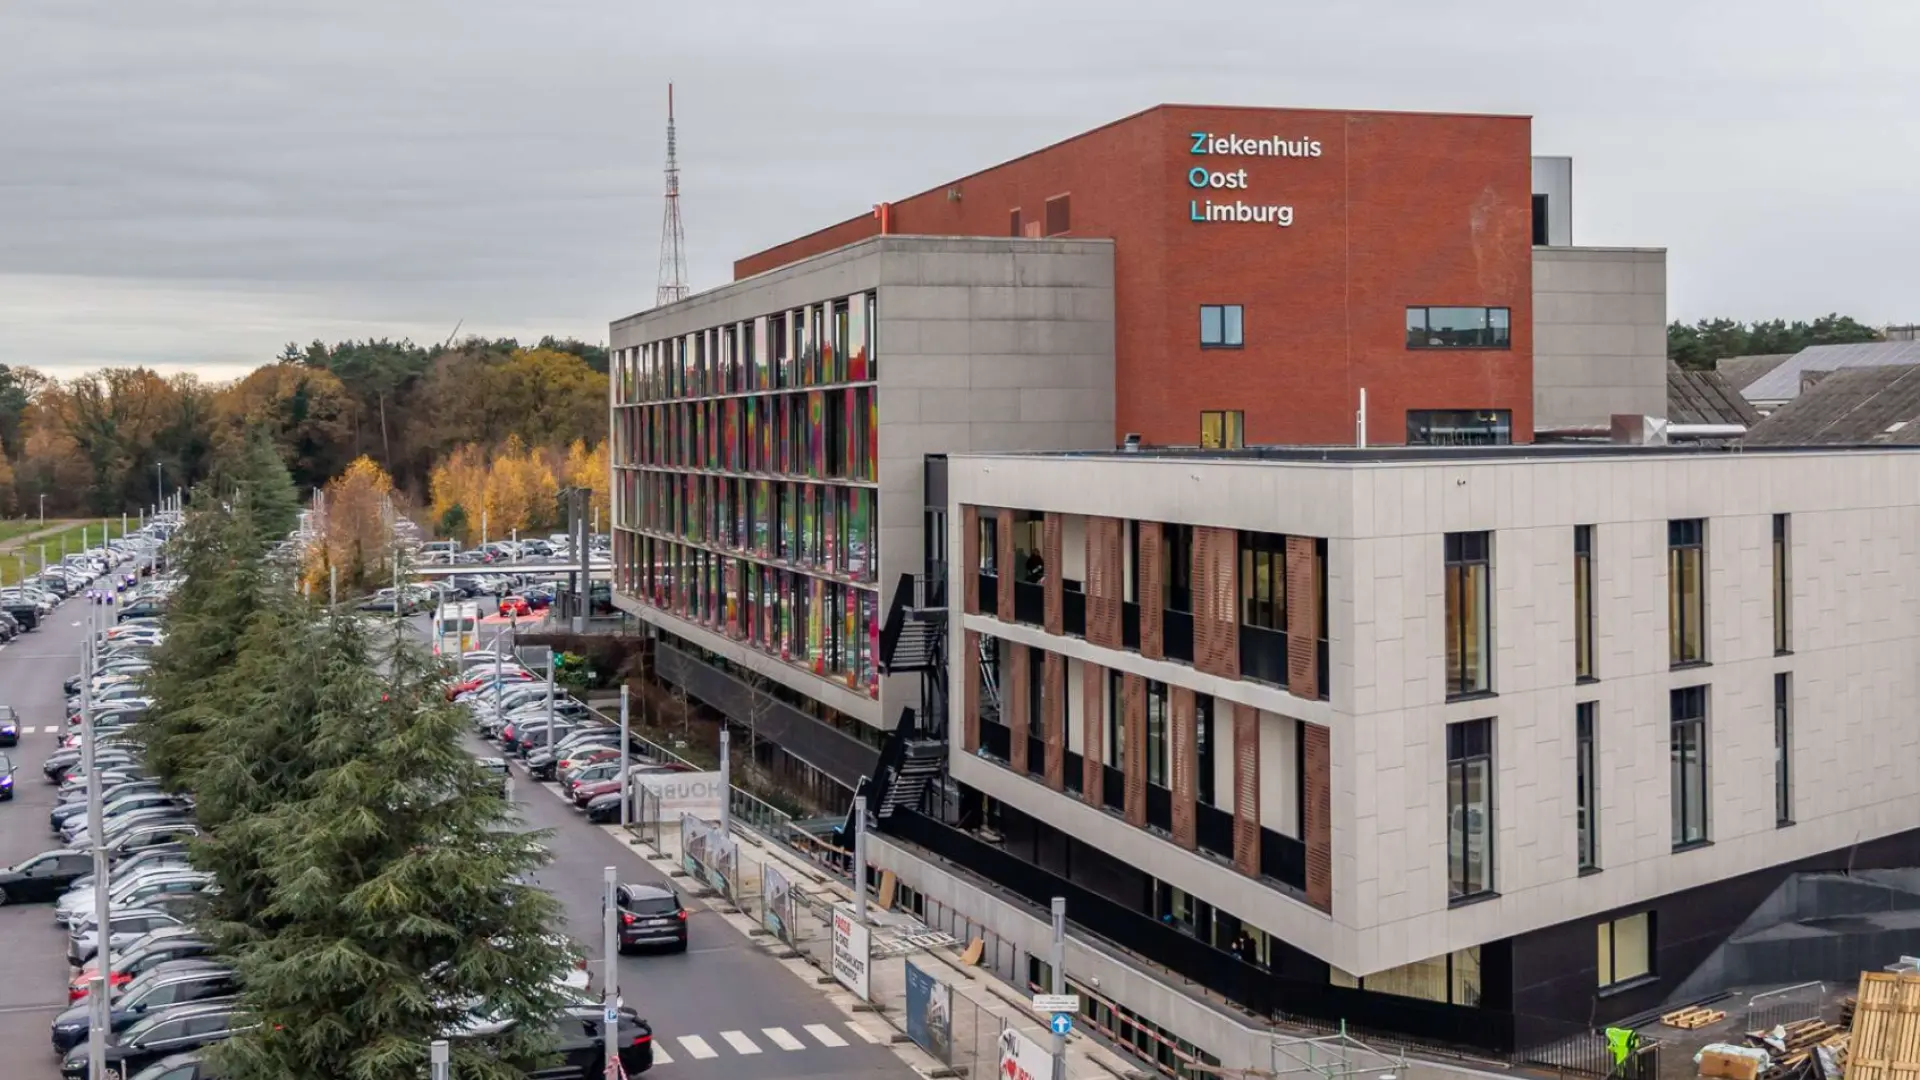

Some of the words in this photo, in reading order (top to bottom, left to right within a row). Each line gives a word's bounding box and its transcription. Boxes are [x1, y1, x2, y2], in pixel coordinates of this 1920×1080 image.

[1190, 132, 1322, 157] Ziekenhuis
[1188, 166, 1248, 189] Oost
[1190, 200, 1294, 226] Limburg
